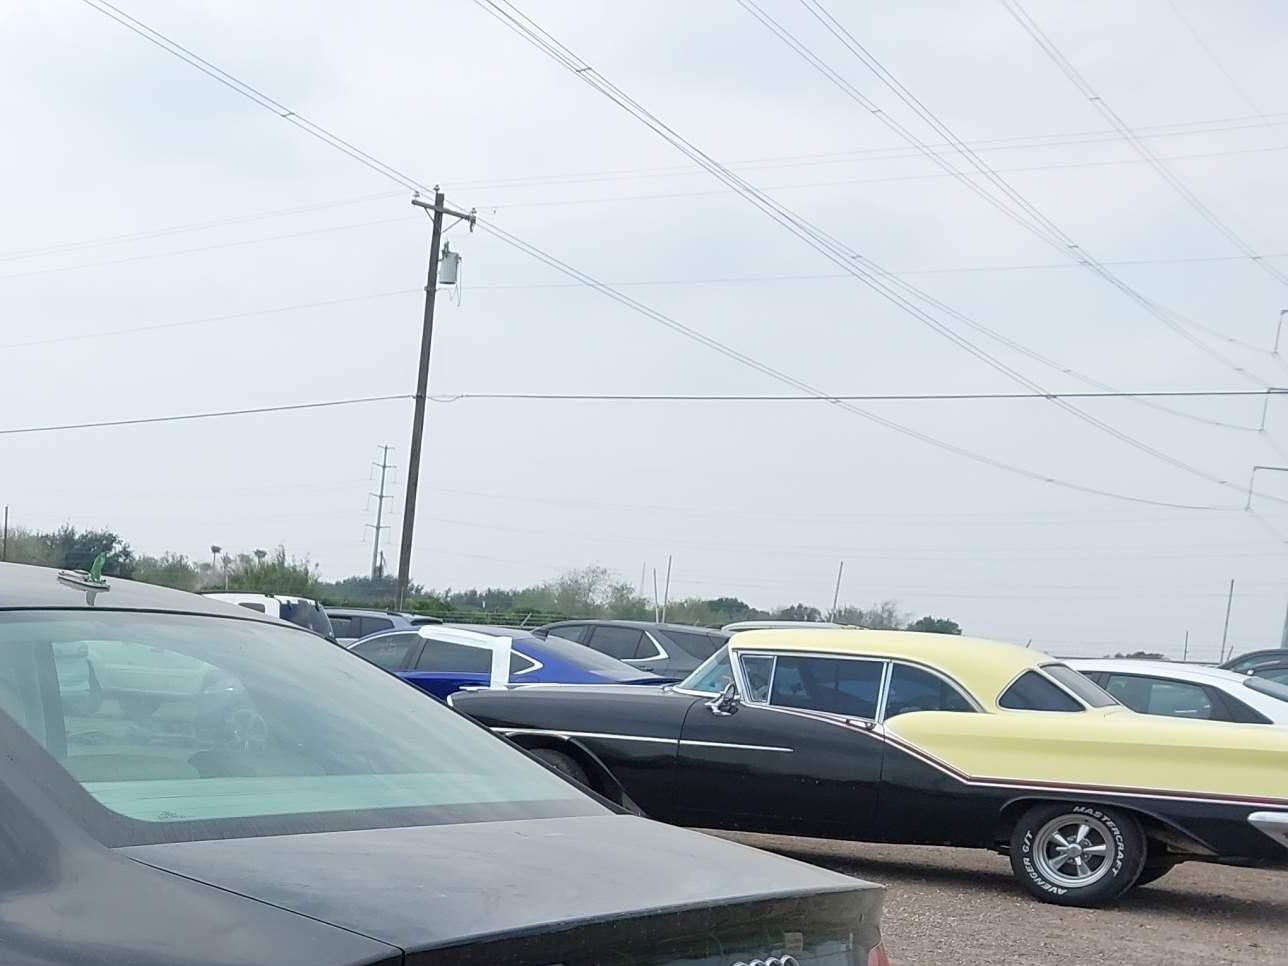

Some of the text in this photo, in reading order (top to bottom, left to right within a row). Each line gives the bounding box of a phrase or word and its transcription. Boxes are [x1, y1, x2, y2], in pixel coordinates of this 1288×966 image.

[1022, 830, 1068, 895] AVENGER G/T
[1073, 806, 1124, 877] MASTERCRAFT
